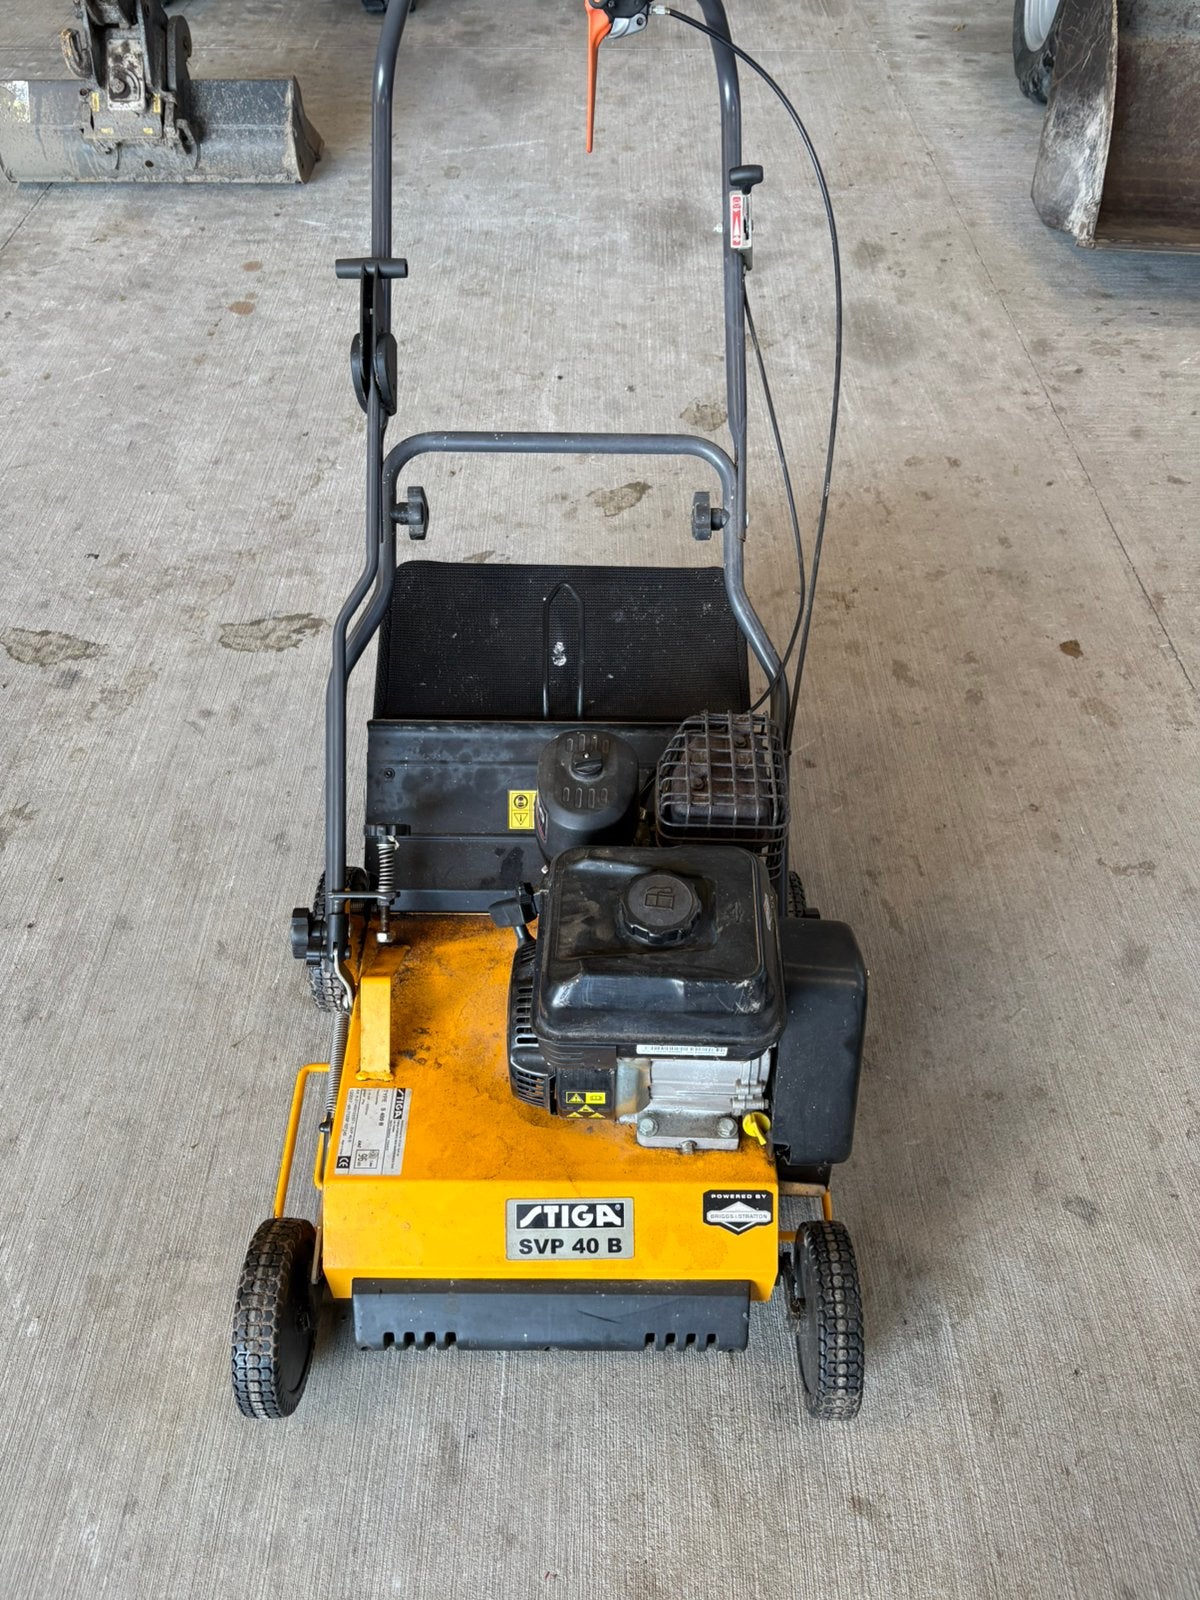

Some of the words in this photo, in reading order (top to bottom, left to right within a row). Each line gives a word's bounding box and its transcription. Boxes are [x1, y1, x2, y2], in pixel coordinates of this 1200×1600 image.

[393, 1088, 406, 1119] STIGA
[357, 1153, 368, 1162] 96
[520, 1204, 622, 1228] STIGA
[519, 1238, 565, 1255] SVP
[572, 1238, 600, 1254] 40
[607, 1238, 623, 1254] B
